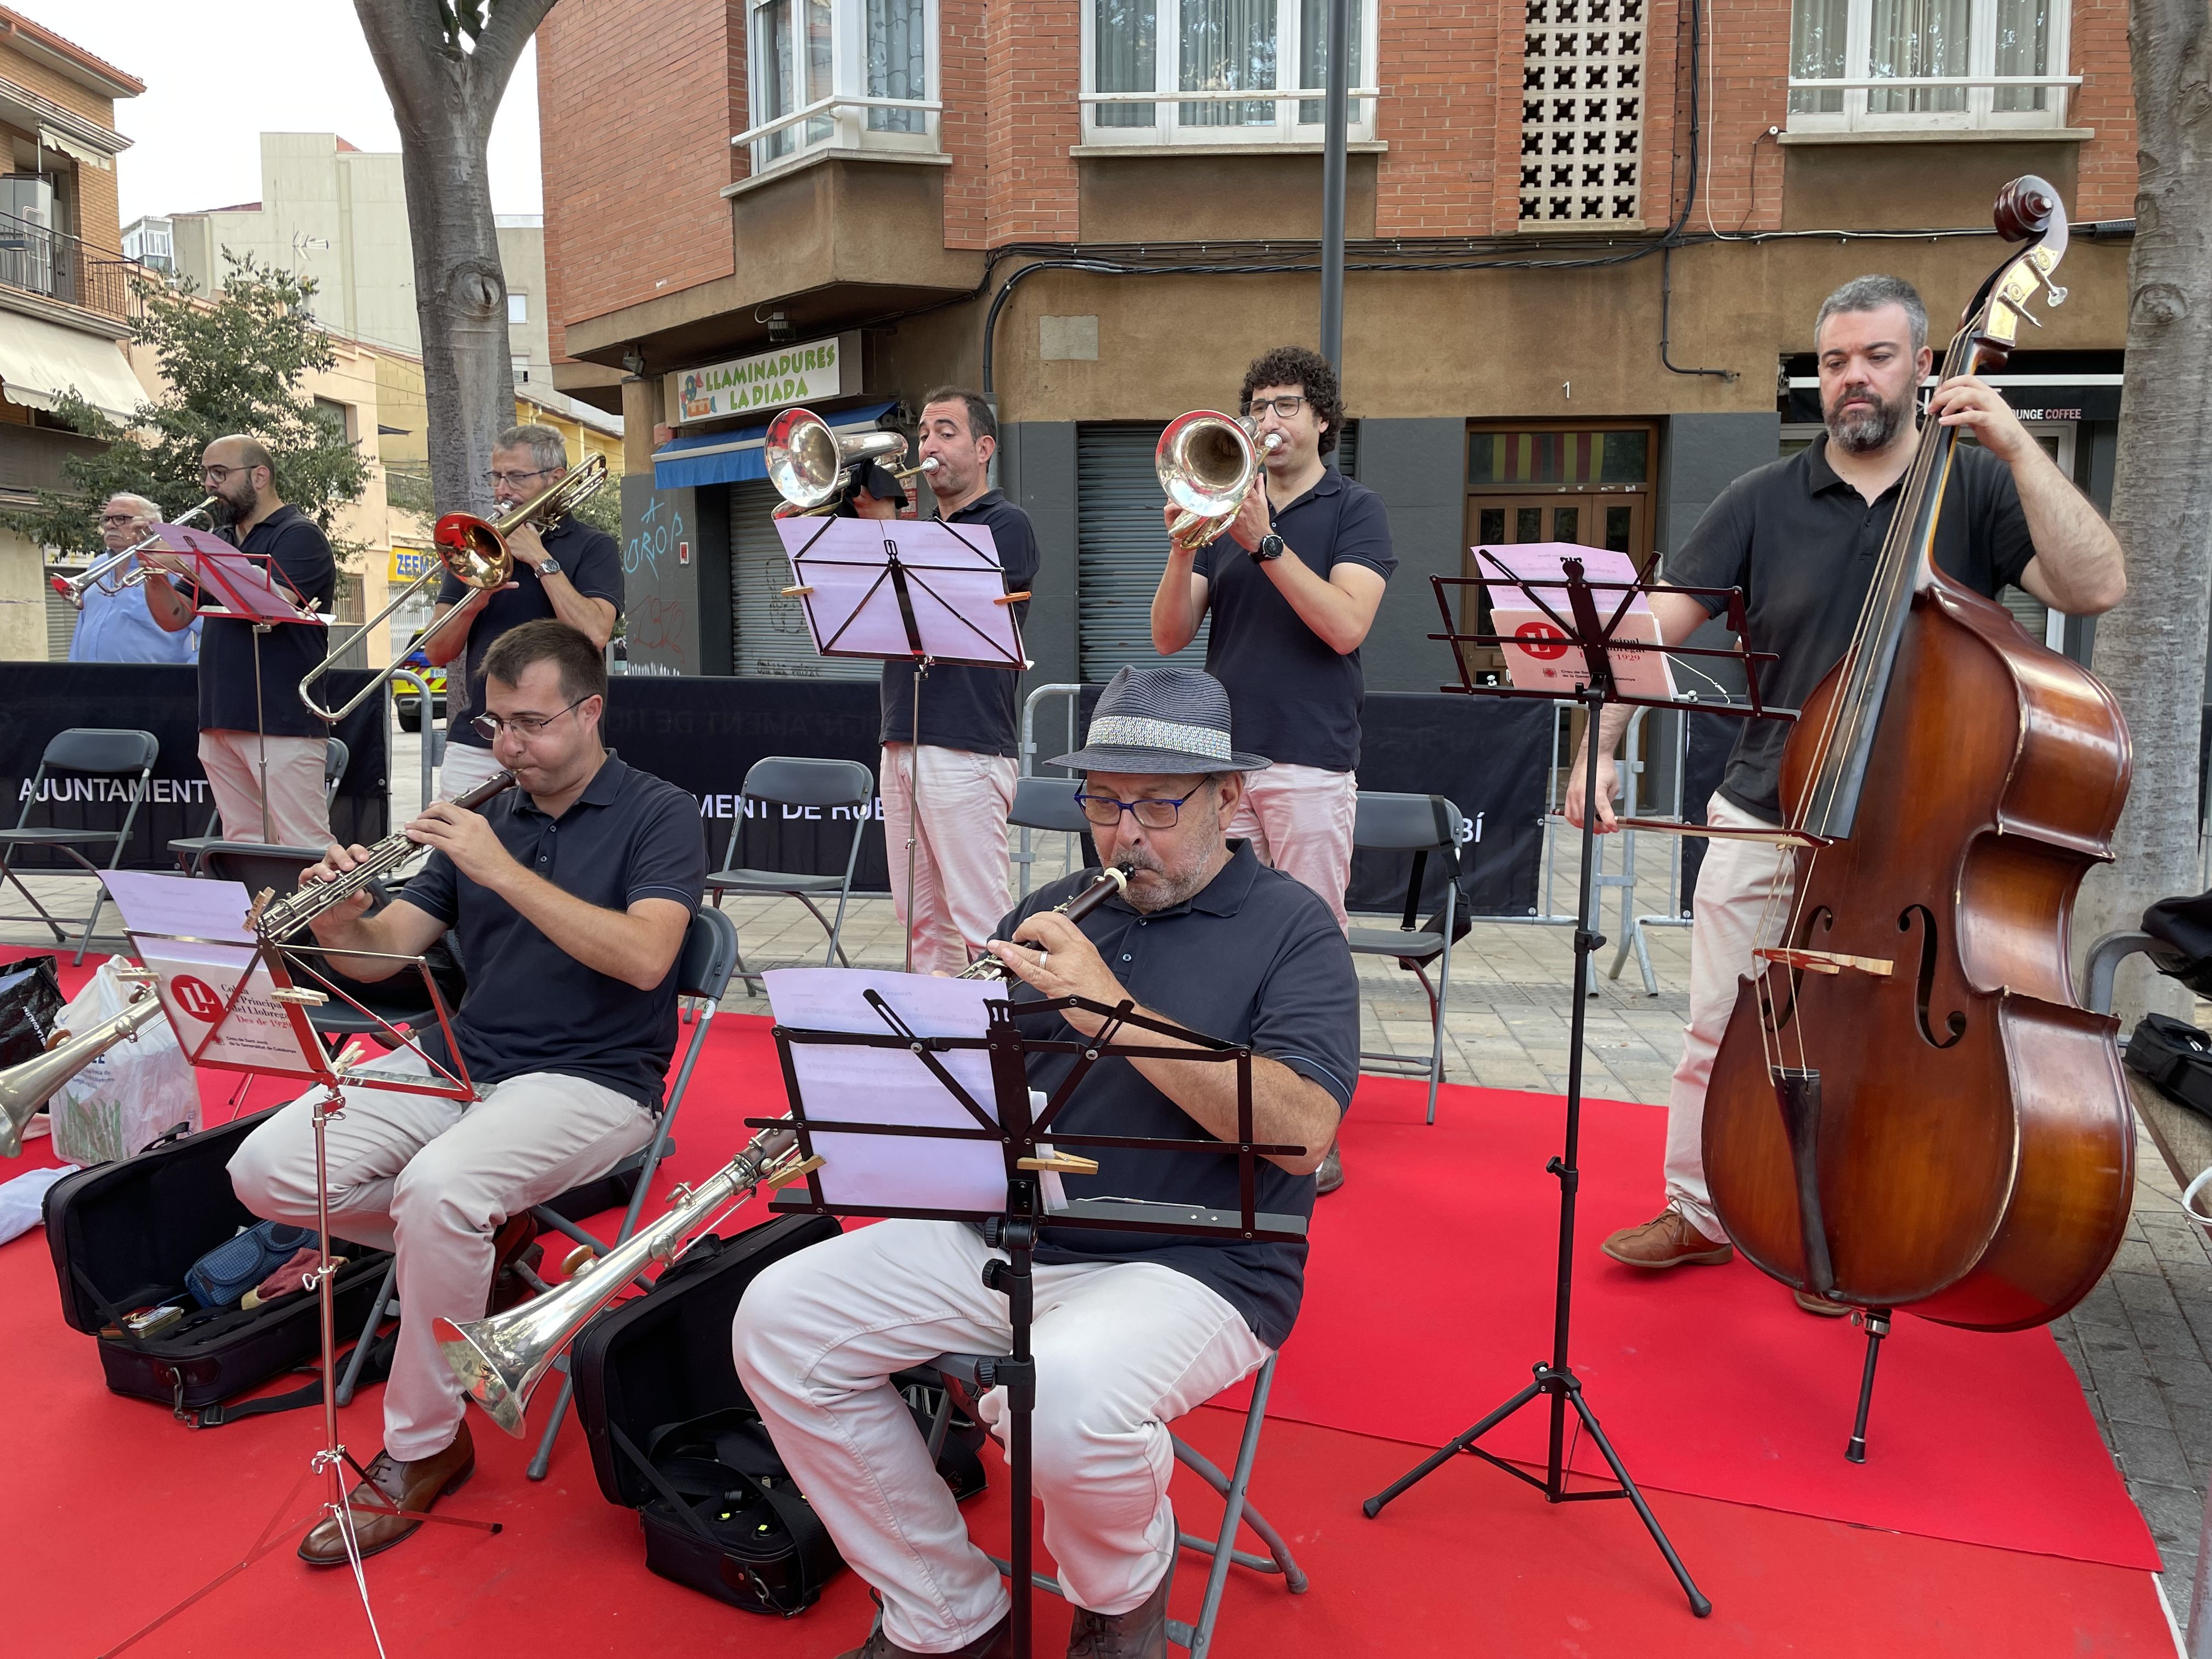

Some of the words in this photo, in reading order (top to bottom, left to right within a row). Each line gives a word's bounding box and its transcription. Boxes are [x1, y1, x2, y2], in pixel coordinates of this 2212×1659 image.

[706, 343, 836, 392] LLAMINADURES
[730, 388, 749, 410] LA
[752, 376, 808, 406] DIADA
[2045, 408, 2082, 420] COFFEE
[19, 777, 208, 803] AJUNTAMENT
[235, 1015, 255, 1024] Des
[256, 1018, 268, 1026] de
[270, 1019, 292, 1029] 1929
